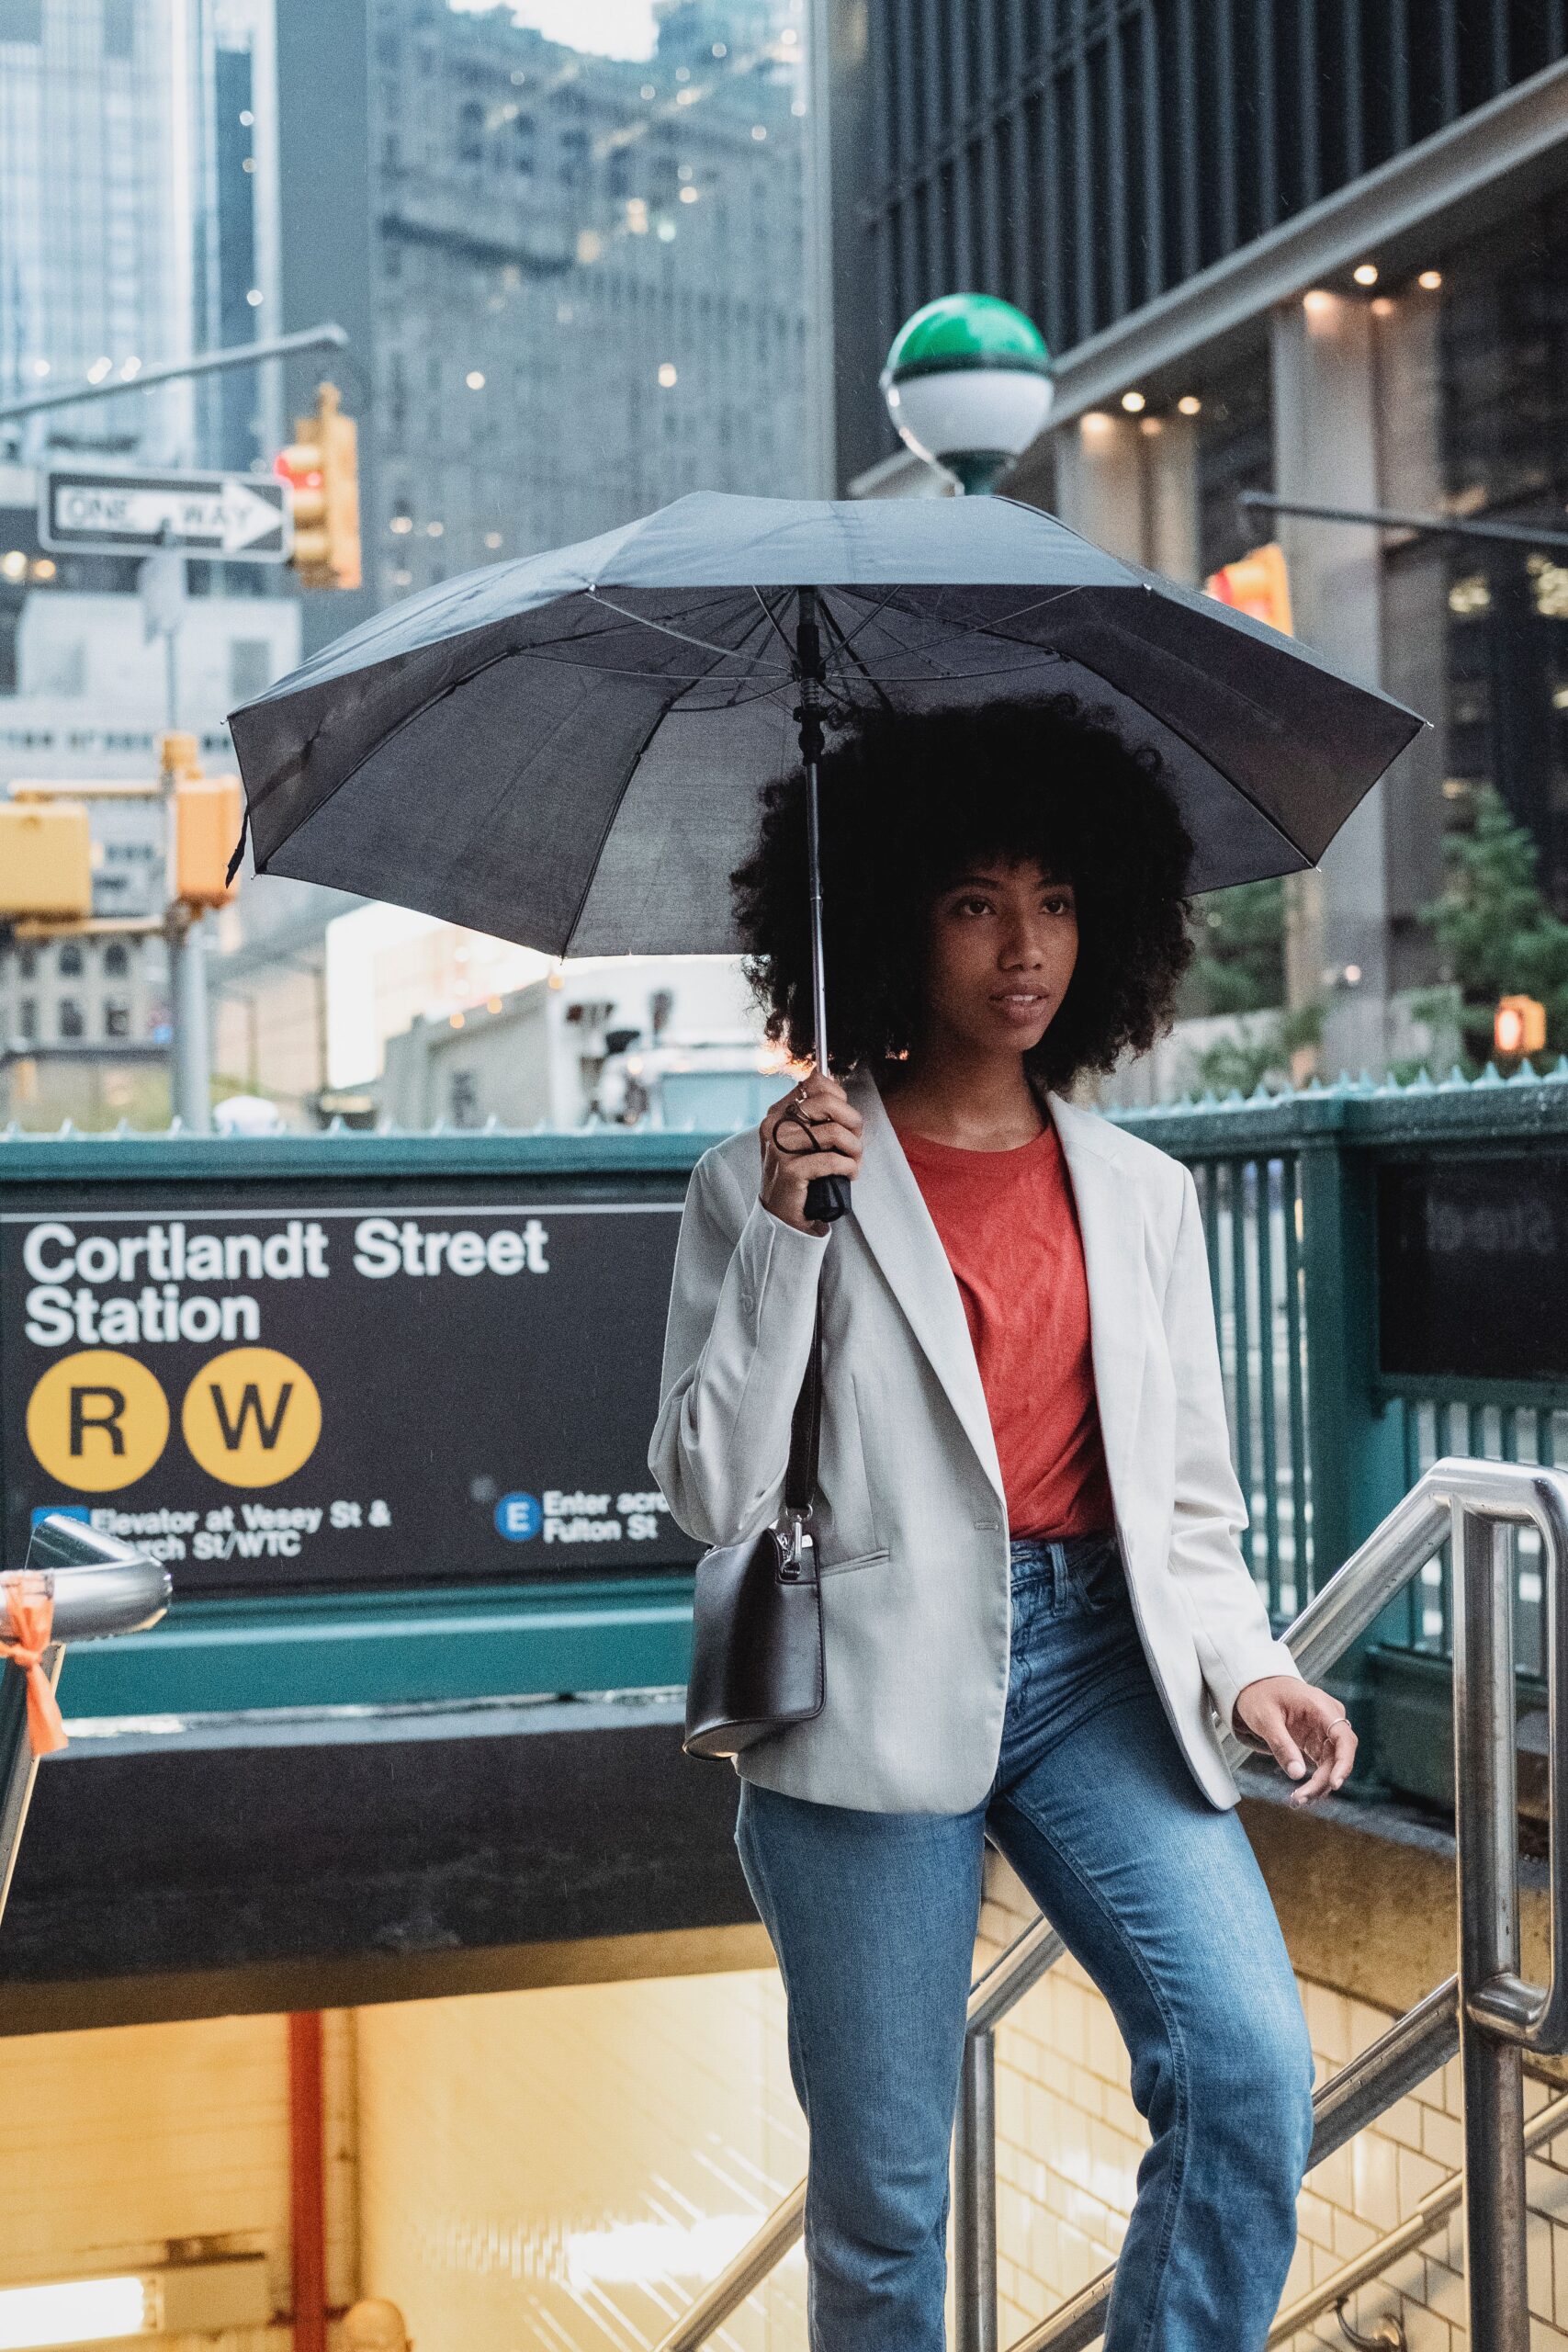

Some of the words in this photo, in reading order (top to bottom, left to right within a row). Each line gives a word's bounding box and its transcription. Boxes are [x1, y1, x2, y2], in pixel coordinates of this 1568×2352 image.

[68, 492, 128, 525] ONE
[183, 499, 252, 529] WAY
[24, 1222, 330, 1283] Cortlandt
[353, 1218, 549, 1279] Street
[25, 1284, 261, 1347] Station
[69, 1385, 127, 1457] R
[209, 1383, 295, 1452] W
[90, 1507, 199, 1535] Elevator
[206, 1505, 233, 1532] at
[242, 1503, 322, 1534] Vesey
[330, 1499, 363, 1529] St
[507, 1501, 531, 1532] E
[543, 1490, 611, 1516] Enter
[616, 1492, 670, 1514] acro
[192, 1528, 302, 1560] St/WTC
[543, 1516, 622, 1544] Fulton
[627, 1514, 659, 1541] St
